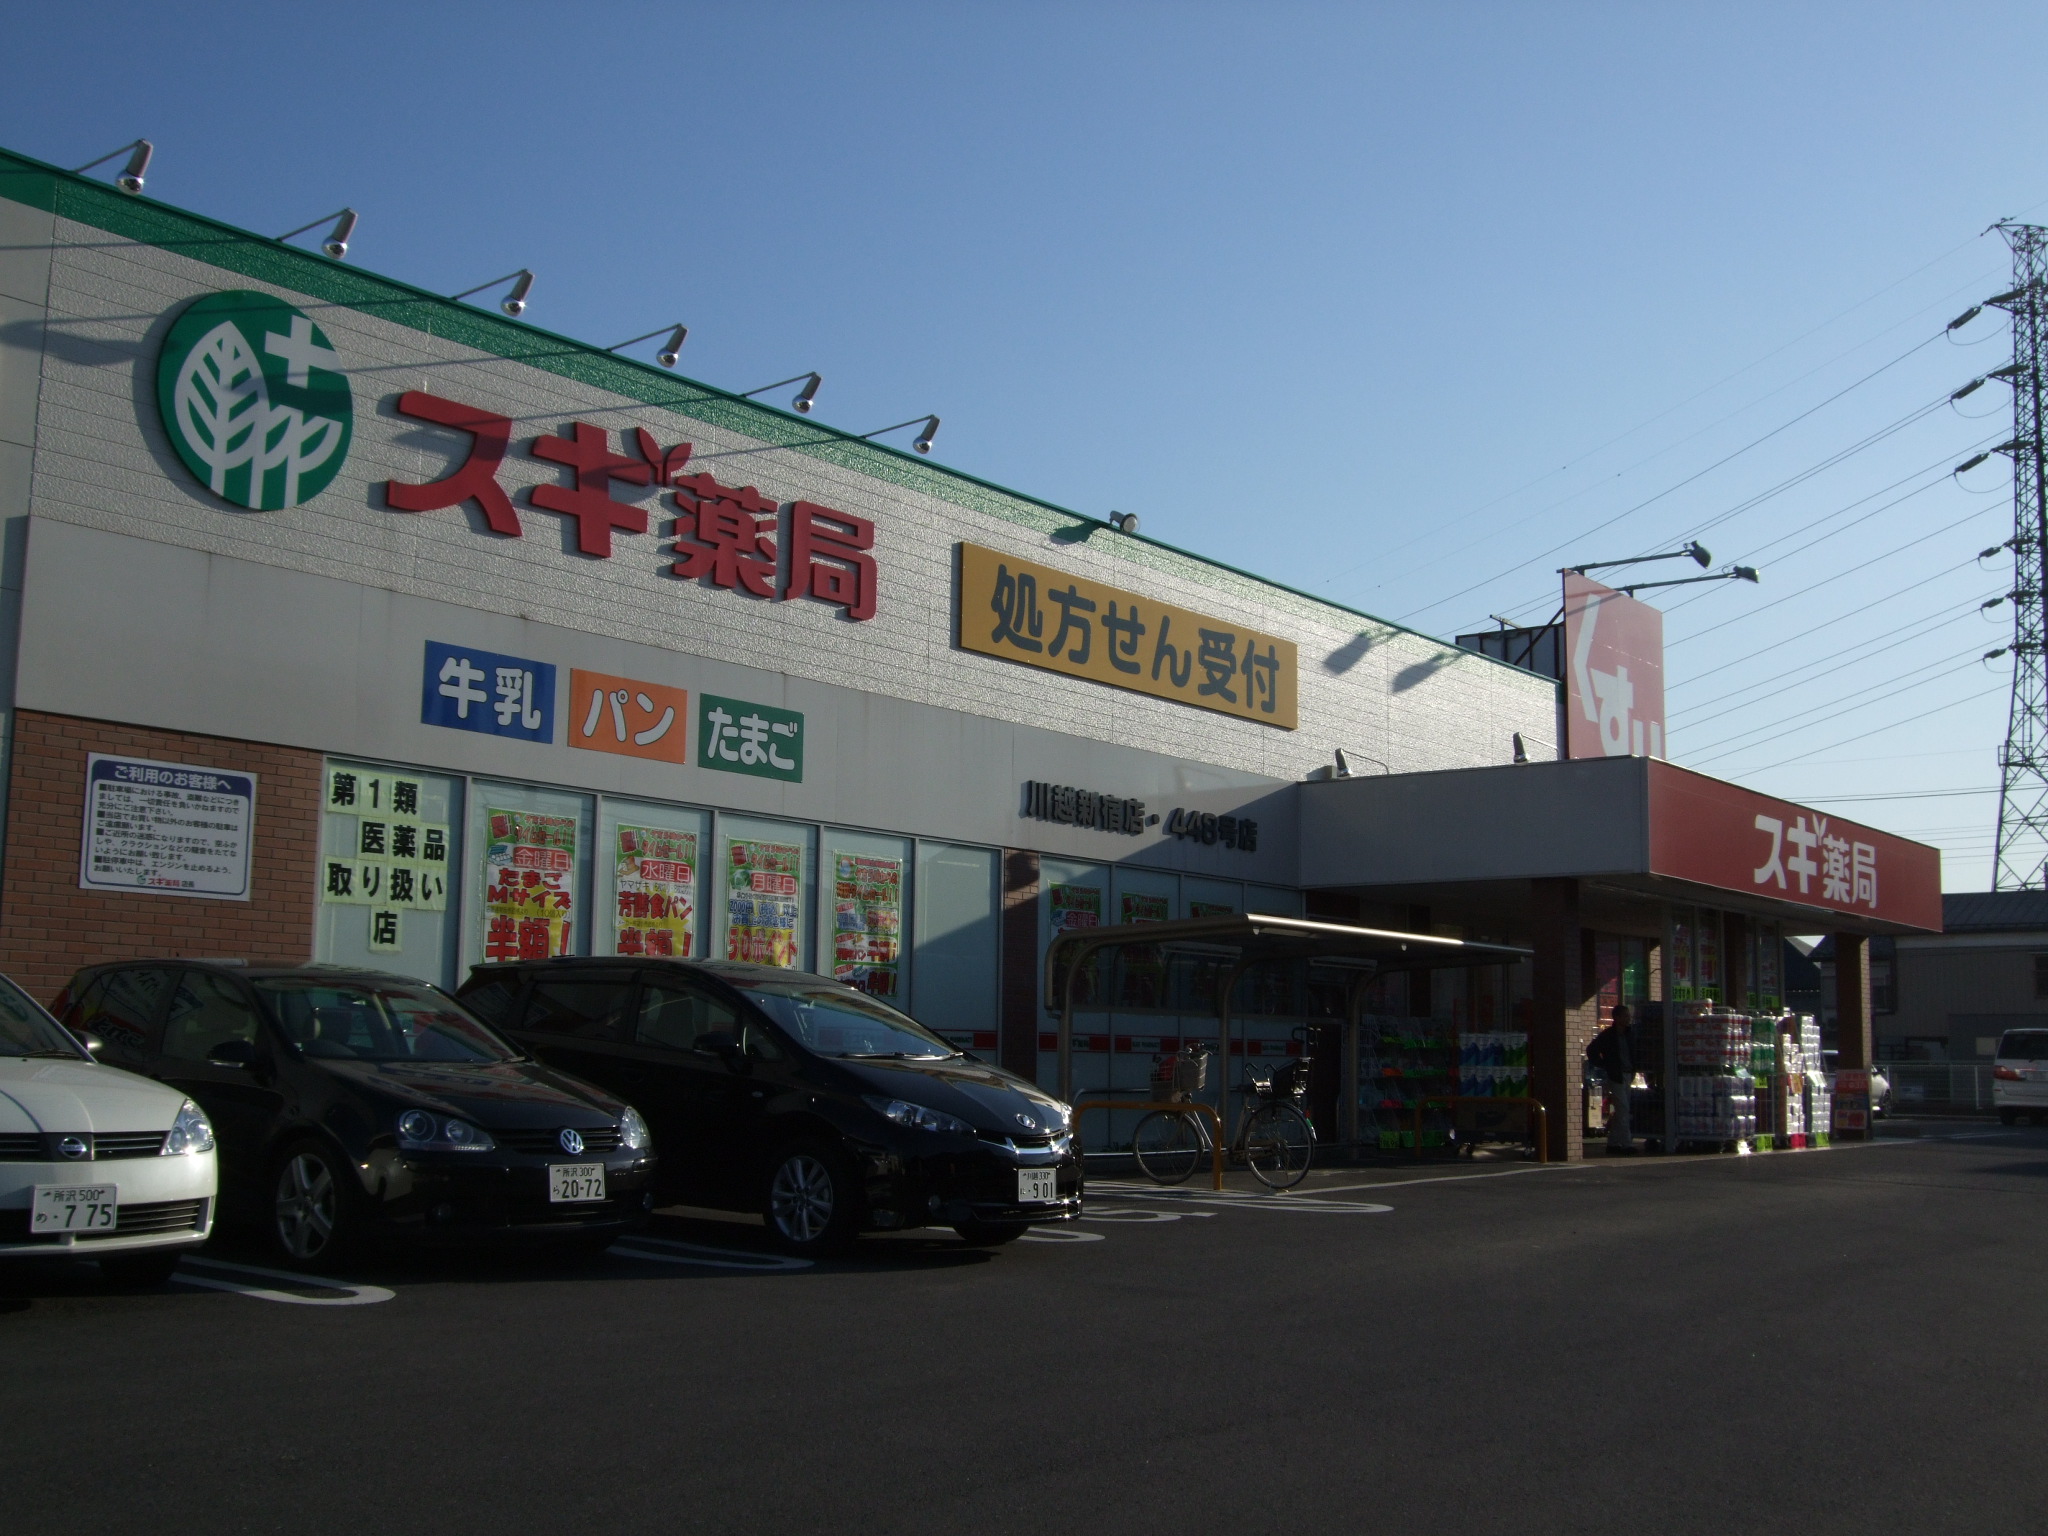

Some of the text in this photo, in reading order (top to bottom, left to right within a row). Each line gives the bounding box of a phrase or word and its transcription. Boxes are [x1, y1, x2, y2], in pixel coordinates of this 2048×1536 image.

[386, 390, 877, 620] スギ薬局
[990, 563, 1280, 713] 処方せん受付
[438, 656, 542, 731] 牛乳
[581, 687, 676, 747] パン
[706, 705, 799, 771] たまご
[114, 764, 232, 791] ご利用のお客様へ
[331, 771, 418, 815] 第1類
[361, 821, 446, 862] 医薬品
[515, 849, 570, 870] 金曜日
[1753, 813, 1878, 909] スギ薬局
[327, 863, 444, 902] 取り扱い
[641, 861, 691, 882] 水曜日
[752, 873, 796, 893] 月曜日
[373, 911, 398, 945] 店
[53, 1189, 100, 1202] 所沢 500
[562, 1179, 602, 1198] 20-72
